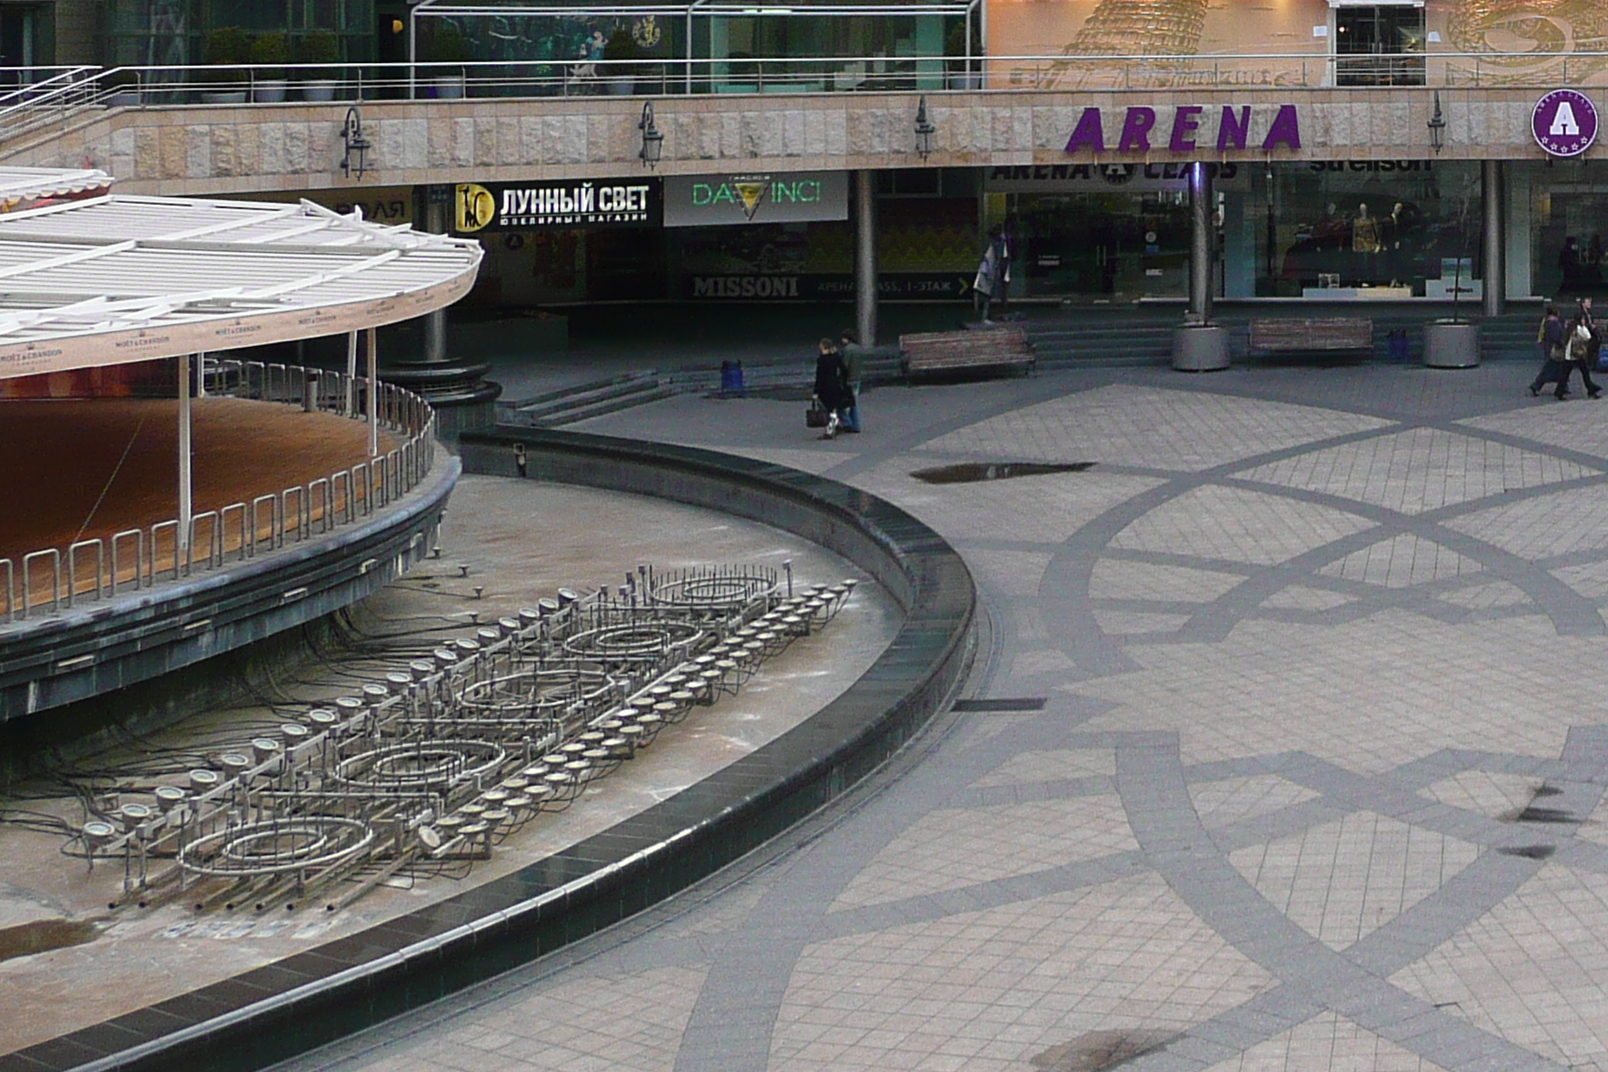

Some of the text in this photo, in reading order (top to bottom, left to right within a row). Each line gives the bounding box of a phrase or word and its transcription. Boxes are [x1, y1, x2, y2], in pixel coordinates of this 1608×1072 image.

[1064, 104, 1302, 153] ARENA
[500, 182, 650, 215] ЛУННЫЙ СВЕТ
[693, 277, 799, 298] MISSONI
